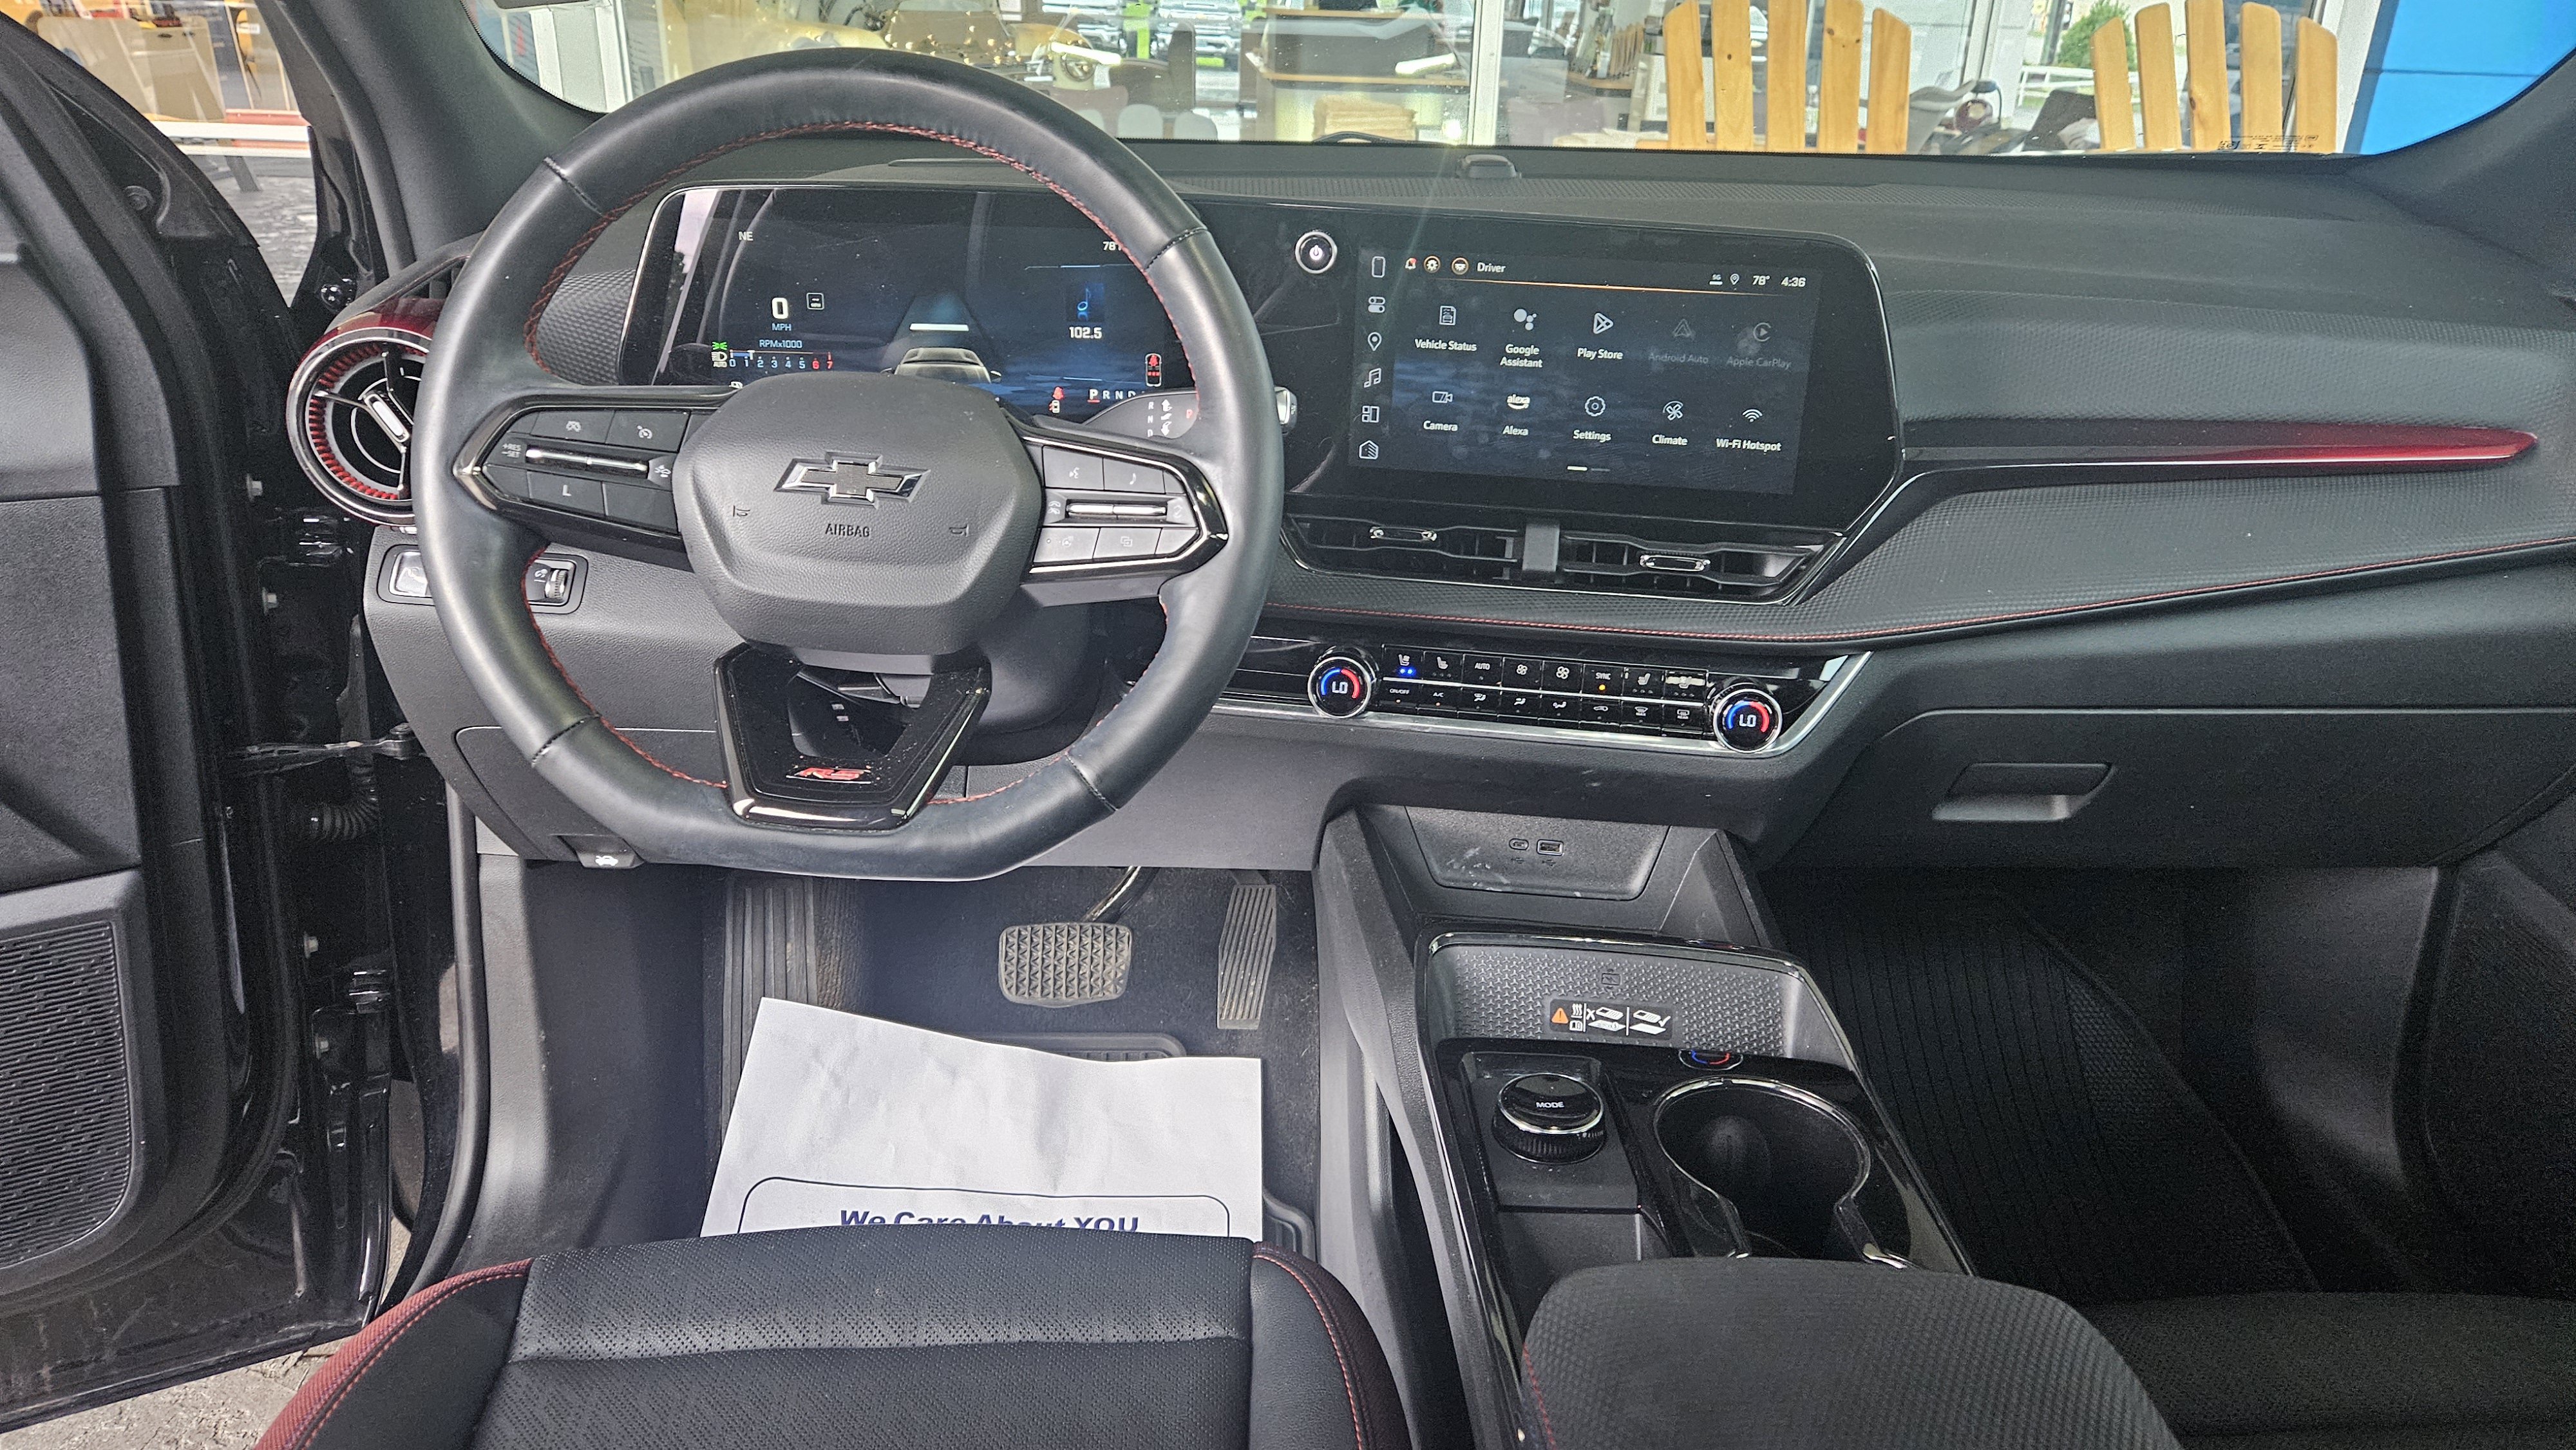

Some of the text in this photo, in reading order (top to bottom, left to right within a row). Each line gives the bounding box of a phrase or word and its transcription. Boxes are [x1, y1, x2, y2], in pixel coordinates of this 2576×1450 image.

[738, 231, 753, 241] NE
[1477, 262, 1506, 273] Driver
[1752, 276, 1770, 285] 78°
[1781, 277, 1806, 287] 4:36
[772, 297, 788, 319] 0
[1069, 326, 1102, 339] 102.5
[759, 339, 802, 348] RPMx1000
[1415, 339, 1477, 352] Vehicle Status
[1505, 344, 1540, 356] Google
[1577, 348, 1624, 360] Play Store
[1500, 356, 1543, 368] Assistant
[1649, 352, 1709, 364] Android Auto
[1727, 355, 1792, 370] Apple CarPlay
[757, 360, 764, 368] 2
[812, 361, 820, 370] 6
[1089, 389, 1098, 399] P
[1103, 390, 1110, 399] R
[1115, 391, 1123, 399] N
[1423, 420, 1458, 431] Camera
[1502, 425, 1529, 436] Alexa
[1573, 429, 1611, 442] Settings
[1652, 434, 1688, 446] Climate
[1716, 438, 1781, 452] Wi-Fi Hotspot
[825, 523, 870, 538] AIRBAG
[1595, 672, 1611, 680] SYNC
[840, 1210, 886, 1225] We
[1074, 1217, 1139, 1232] YOU
